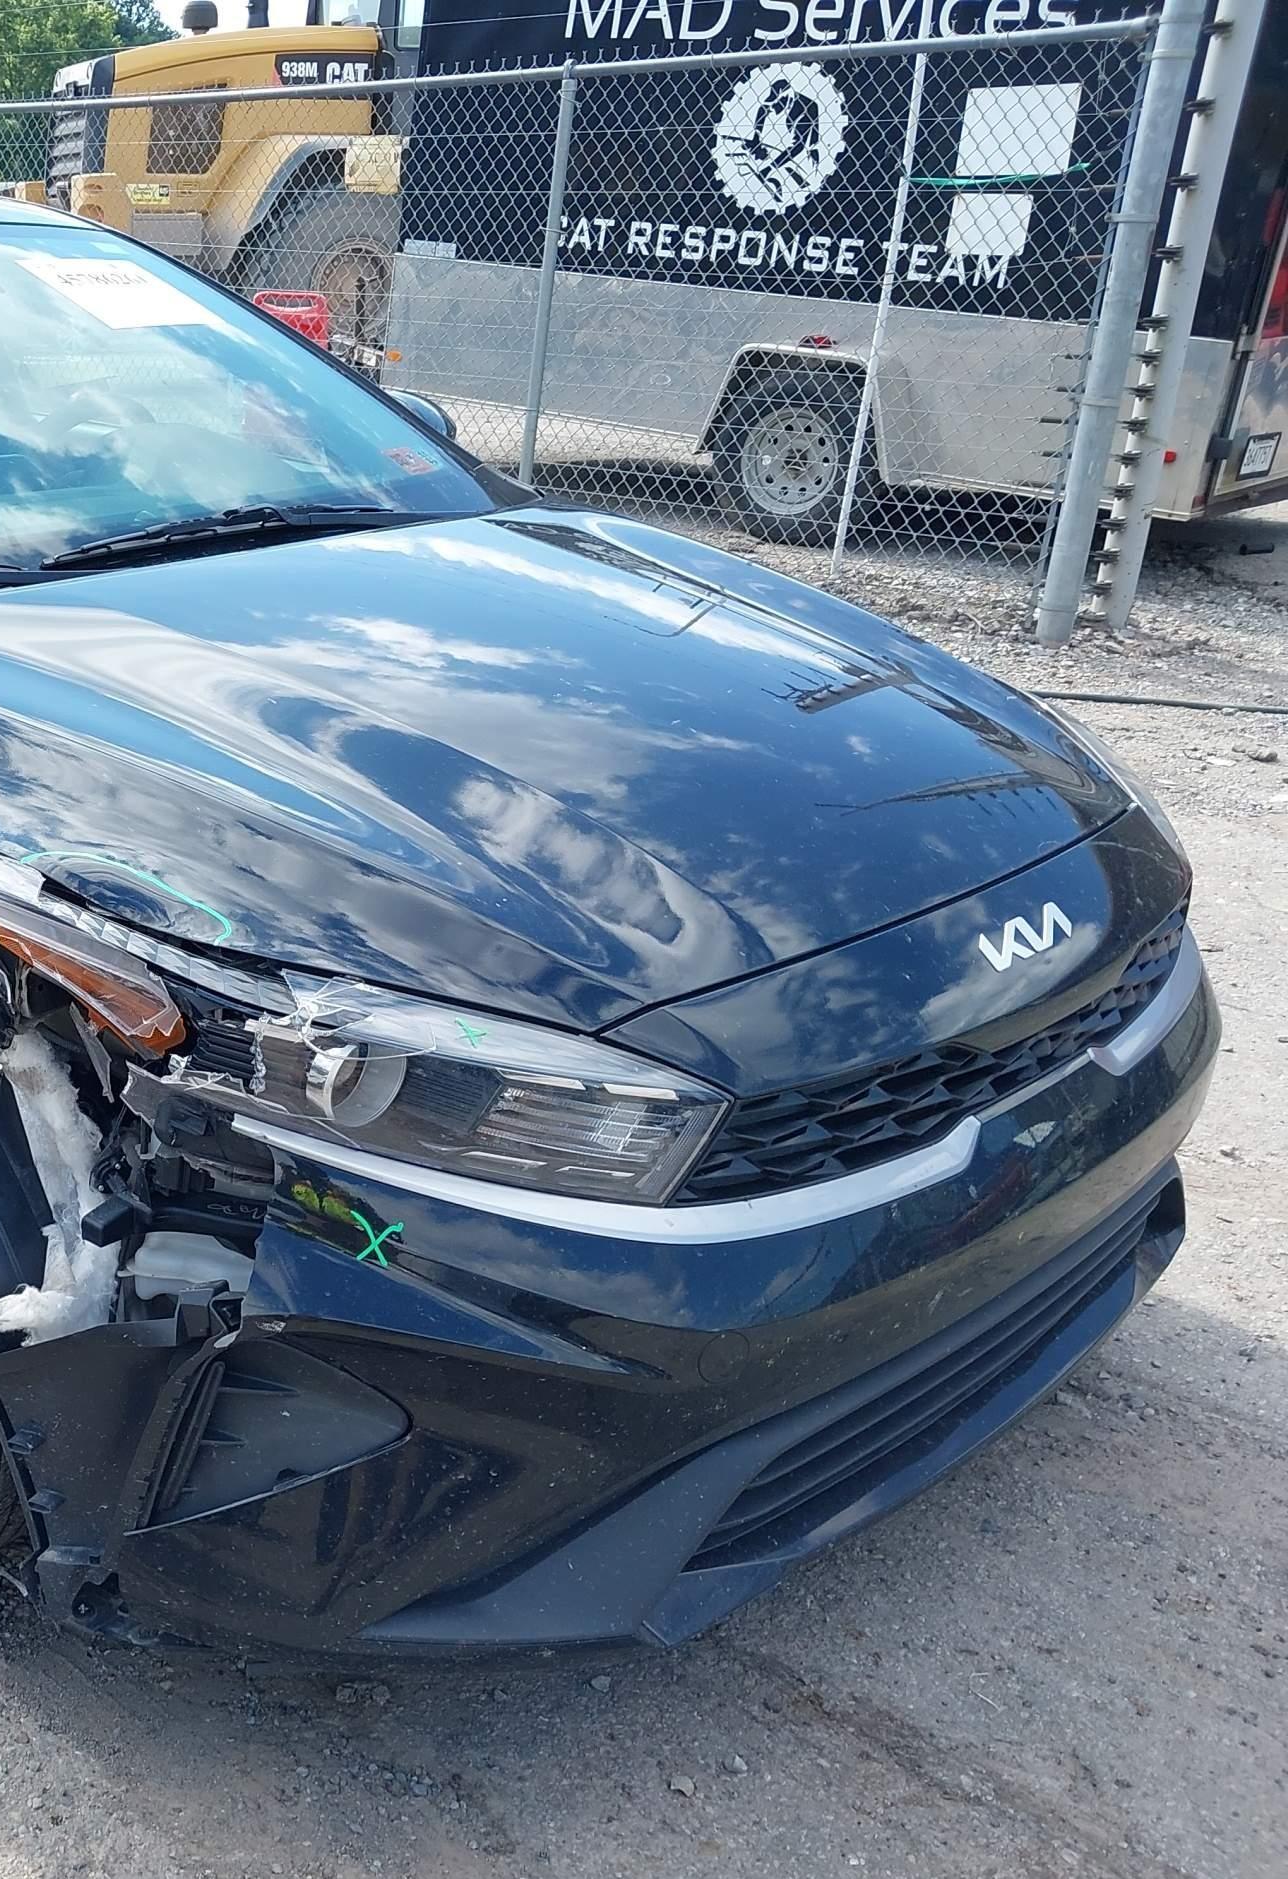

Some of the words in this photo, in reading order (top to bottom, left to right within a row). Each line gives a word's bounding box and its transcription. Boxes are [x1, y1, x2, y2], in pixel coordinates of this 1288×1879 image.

[564, 0, 733, 40] MAD
[281, 61, 318, 78] 938M
[326, 62, 369, 84] CAT
[627, 221, 865, 276] RESPONSE
